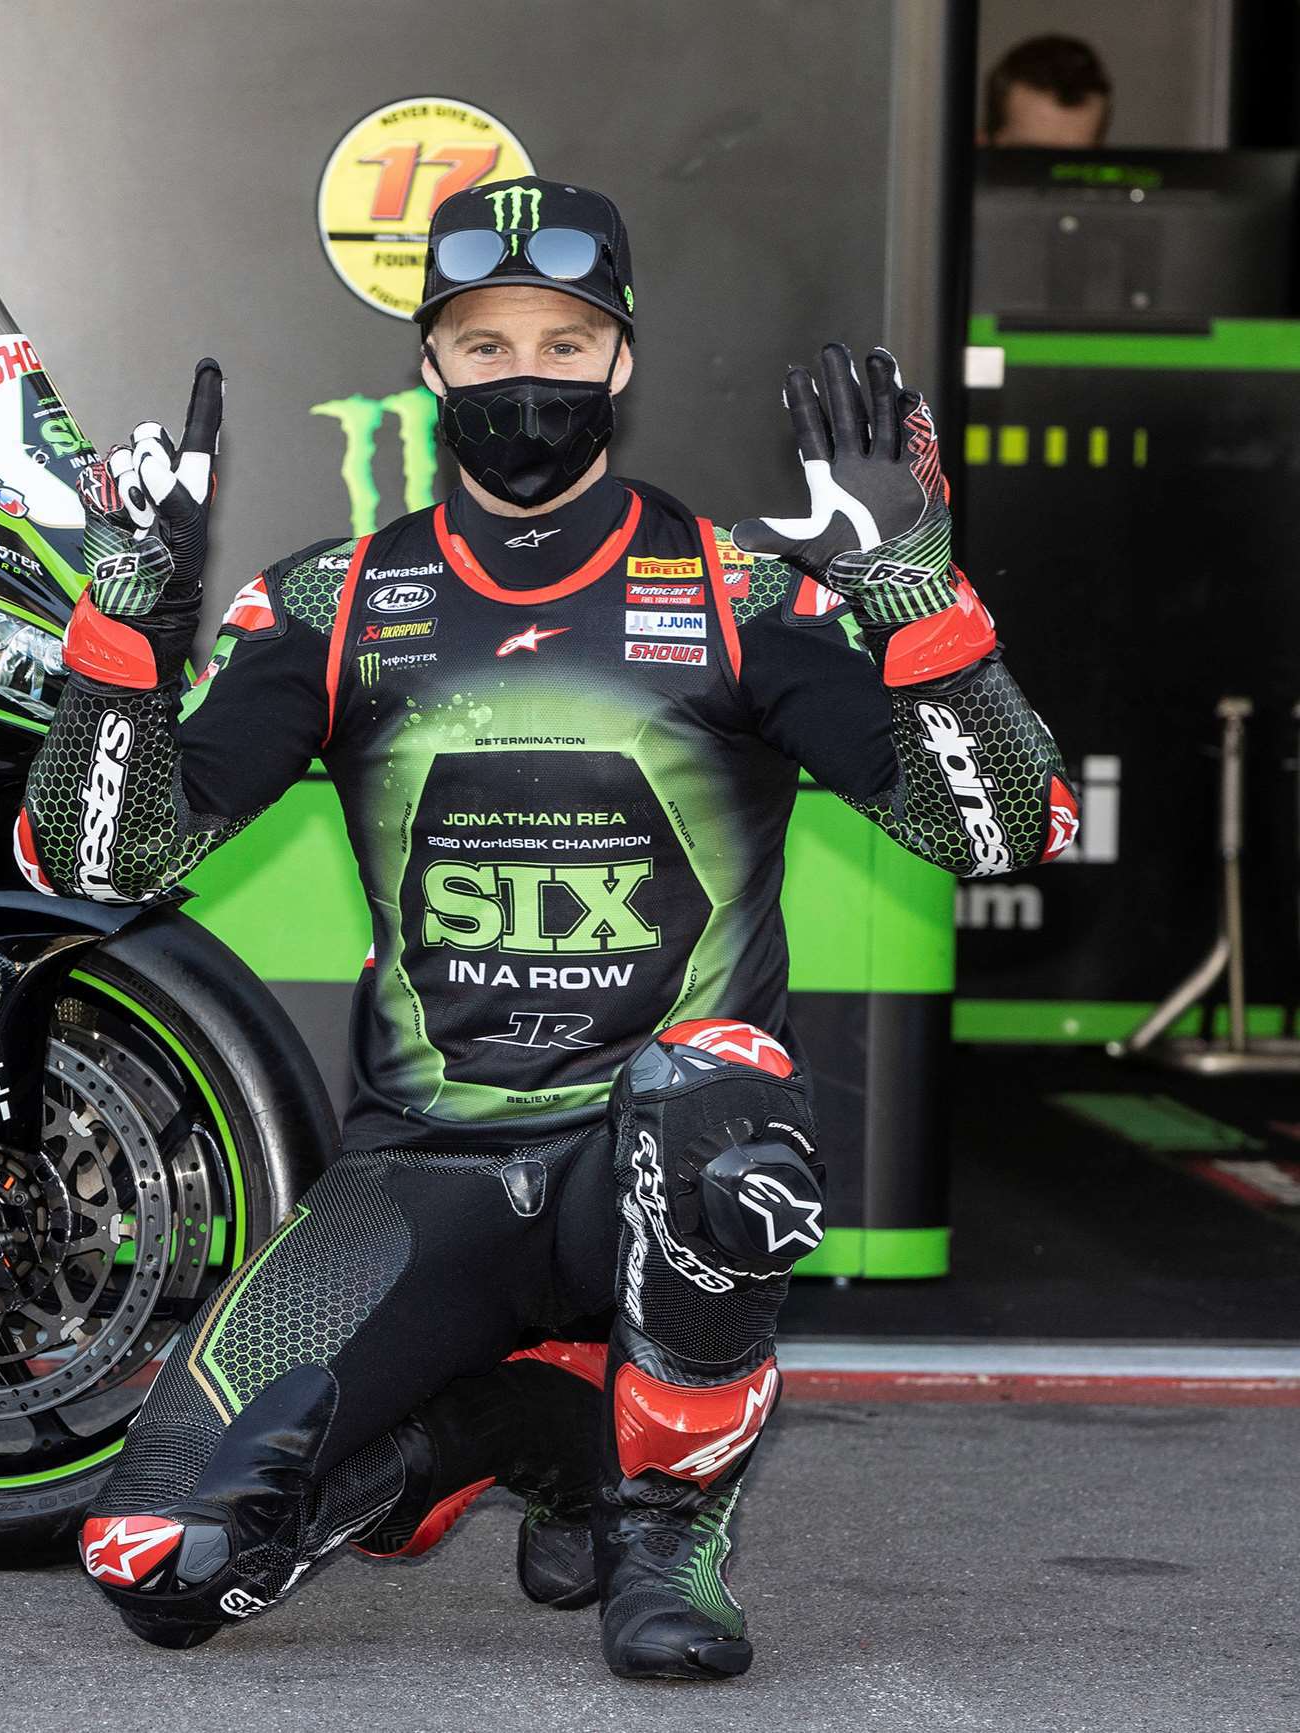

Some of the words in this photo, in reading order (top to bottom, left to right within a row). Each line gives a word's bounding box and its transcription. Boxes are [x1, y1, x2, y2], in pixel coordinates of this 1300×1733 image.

[357, 142, 501, 221] 17
[94, 553, 139, 582] 65
[365, 562, 444, 580] Kawasaki
[635, 561, 696, 574] PIRELLI
[865, 562, 935, 586] 65
[373, 587, 429, 604] Arai
[657, 616, 703, 629] J.JUAN
[382, 653, 437, 666] MONSTER
[628, 644, 704, 663] SHOWA
[475, 737, 585, 746] DETERMINATION
[402, 801, 413, 854] SACRIFICE
[442, 813, 571, 827] JONATHAN
[577, 812, 626, 826] REA
[668, 801, 696, 850] ATTITUDE
[427, 836, 460, 848] 2020
[463, 837, 549, 850] WorldSBK
[552, 836, 651, 850] CHAMPION
[422, 858, 661, 956] SIX
[448, 960, 485, 984] IN
[490, 963, 520, 988] A
[529, 963, 635, 990] ROW
[394, 967, 415, 1000] TEAM
[411, 1000, 422, 1041] WORK
[663, 965, 698, 1029] ONSTANCY
[472, 1012, 604, 1050] JR
[506, 1094, 561, 1104] BELIEVE
